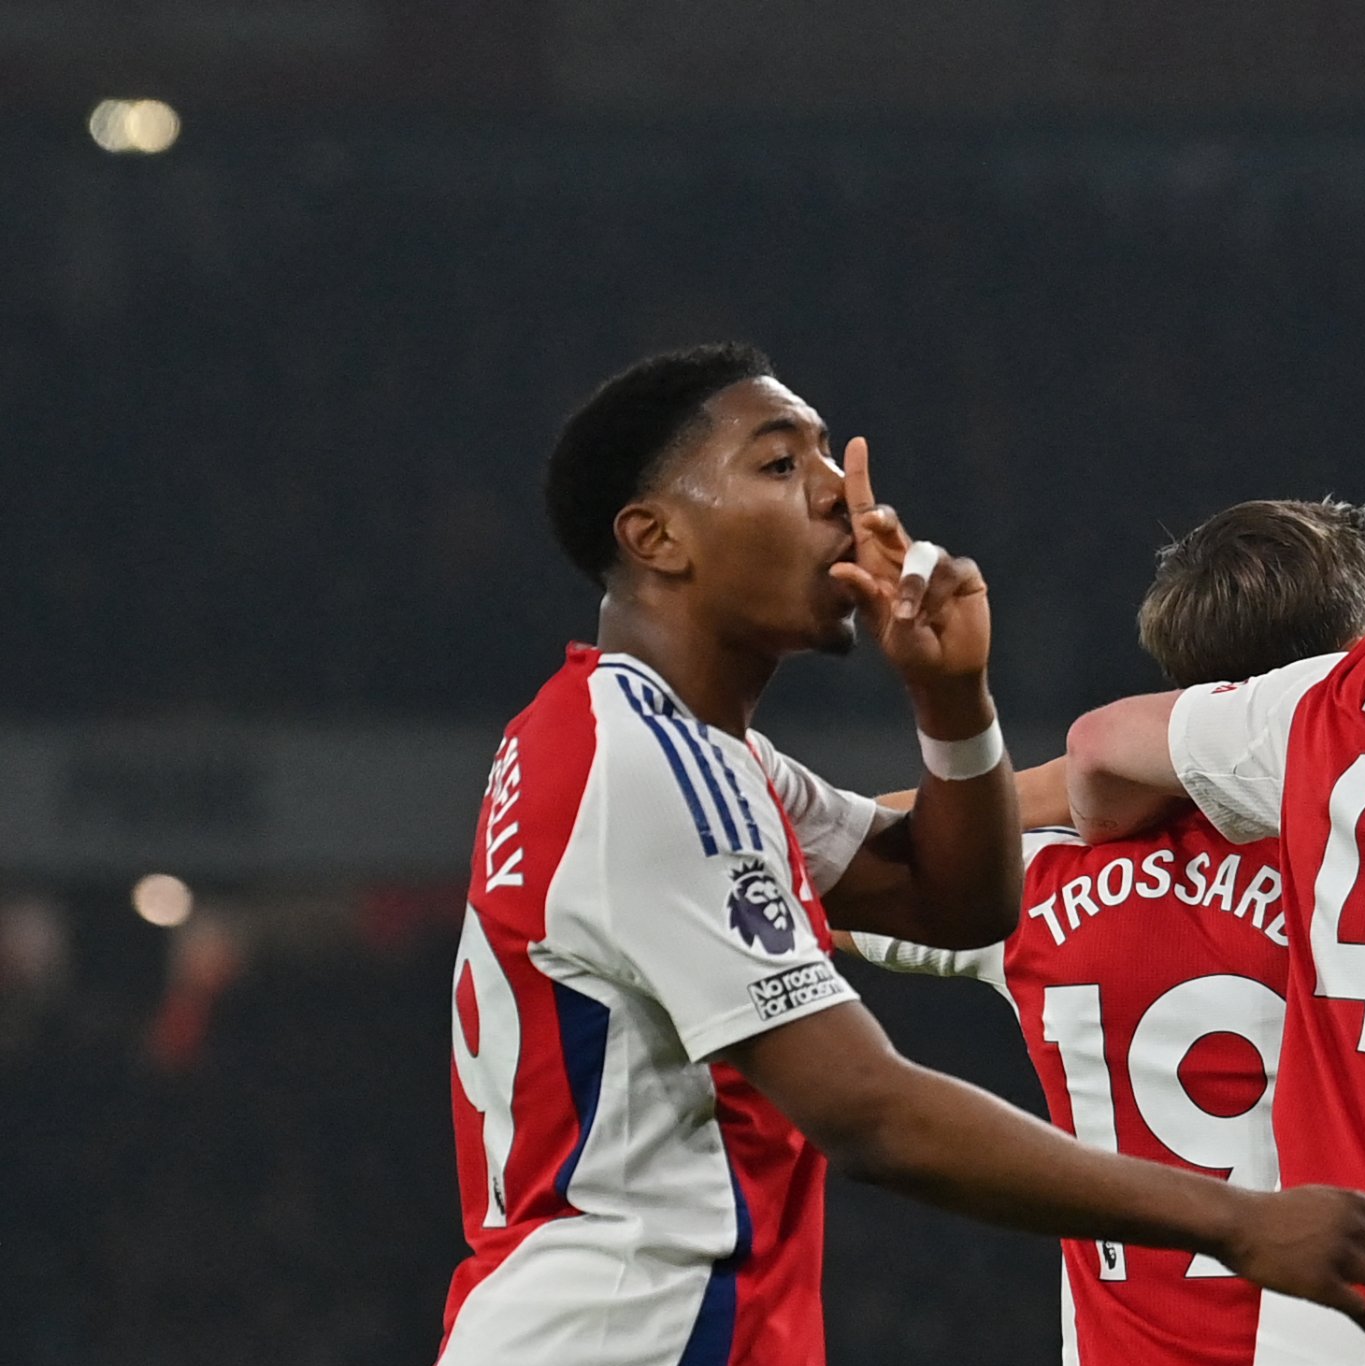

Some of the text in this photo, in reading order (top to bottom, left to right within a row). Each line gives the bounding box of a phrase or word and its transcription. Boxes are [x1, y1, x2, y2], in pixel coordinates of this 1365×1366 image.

[748, 963, 834, 1004] No room
[1042, 973, 1288, 1281] 19
